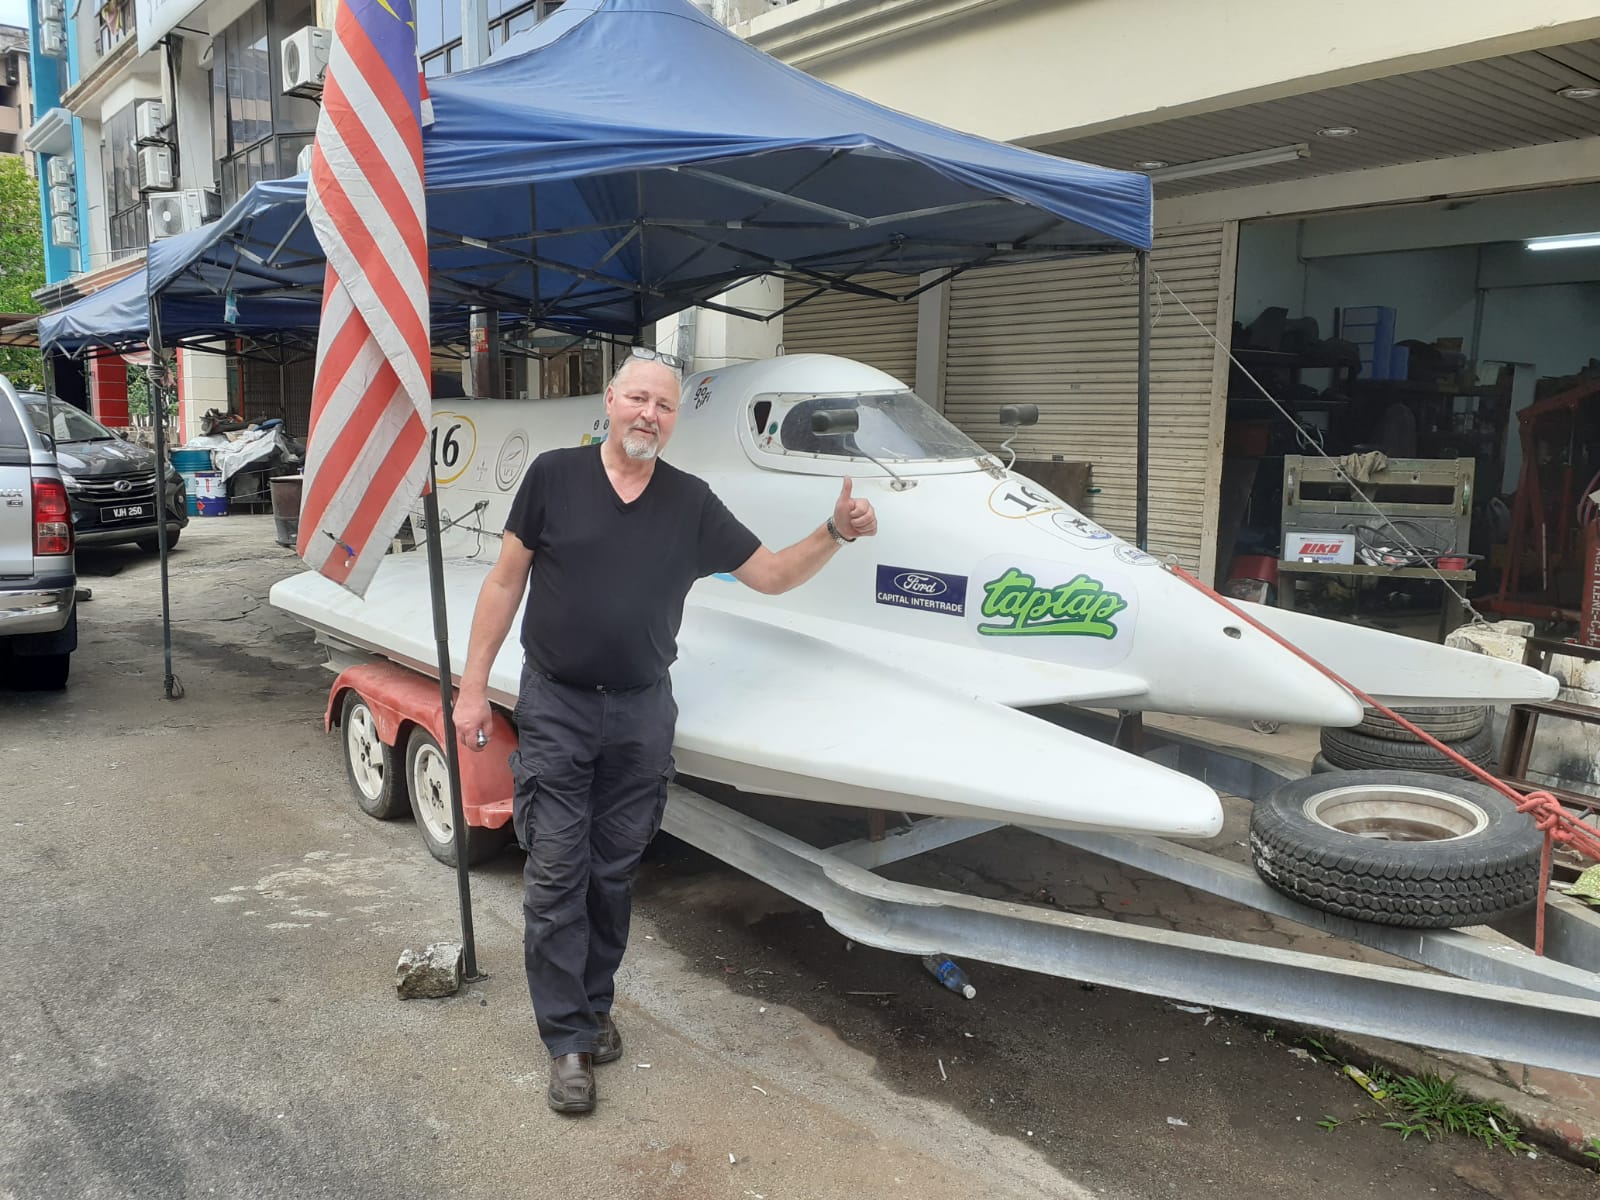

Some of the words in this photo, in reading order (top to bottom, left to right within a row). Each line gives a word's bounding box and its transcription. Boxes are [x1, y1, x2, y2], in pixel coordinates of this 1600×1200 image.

[431, 424, 462, 467] 16
[1004, 486, 1050, 511] 16
[113, 508, 127, 518] VJH
[128, 506, 142, 516] 250
[903, 574, 937, 593] Ford
[877, 592, 909, 604] CAPITAL
[911, 598, 963, 613] INTERTRADE
[977, 567, 1128, 639] taptap
